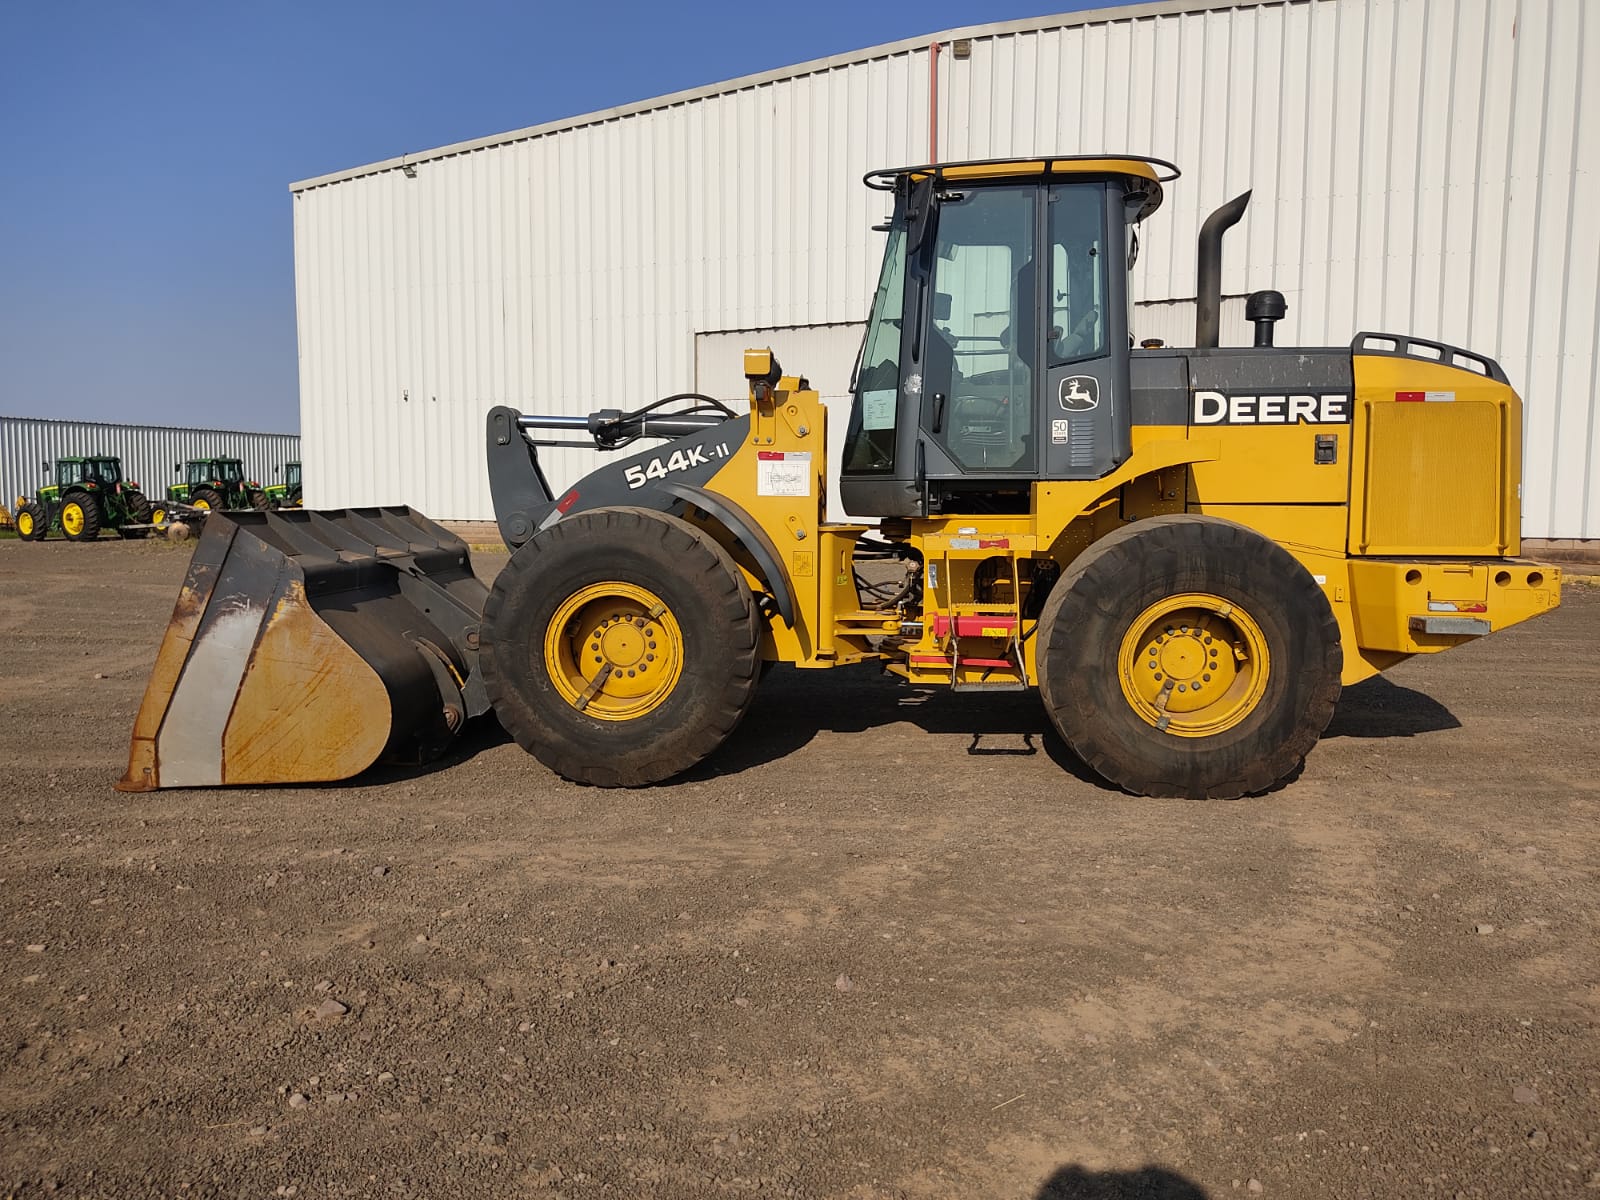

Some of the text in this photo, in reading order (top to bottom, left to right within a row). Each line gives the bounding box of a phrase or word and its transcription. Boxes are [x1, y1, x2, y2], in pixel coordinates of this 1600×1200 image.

[1194, 391, 1347, 423] DEERE
[1053, 421, 1066, 431] 50
[624, 442, 730, 489] 544K-II
